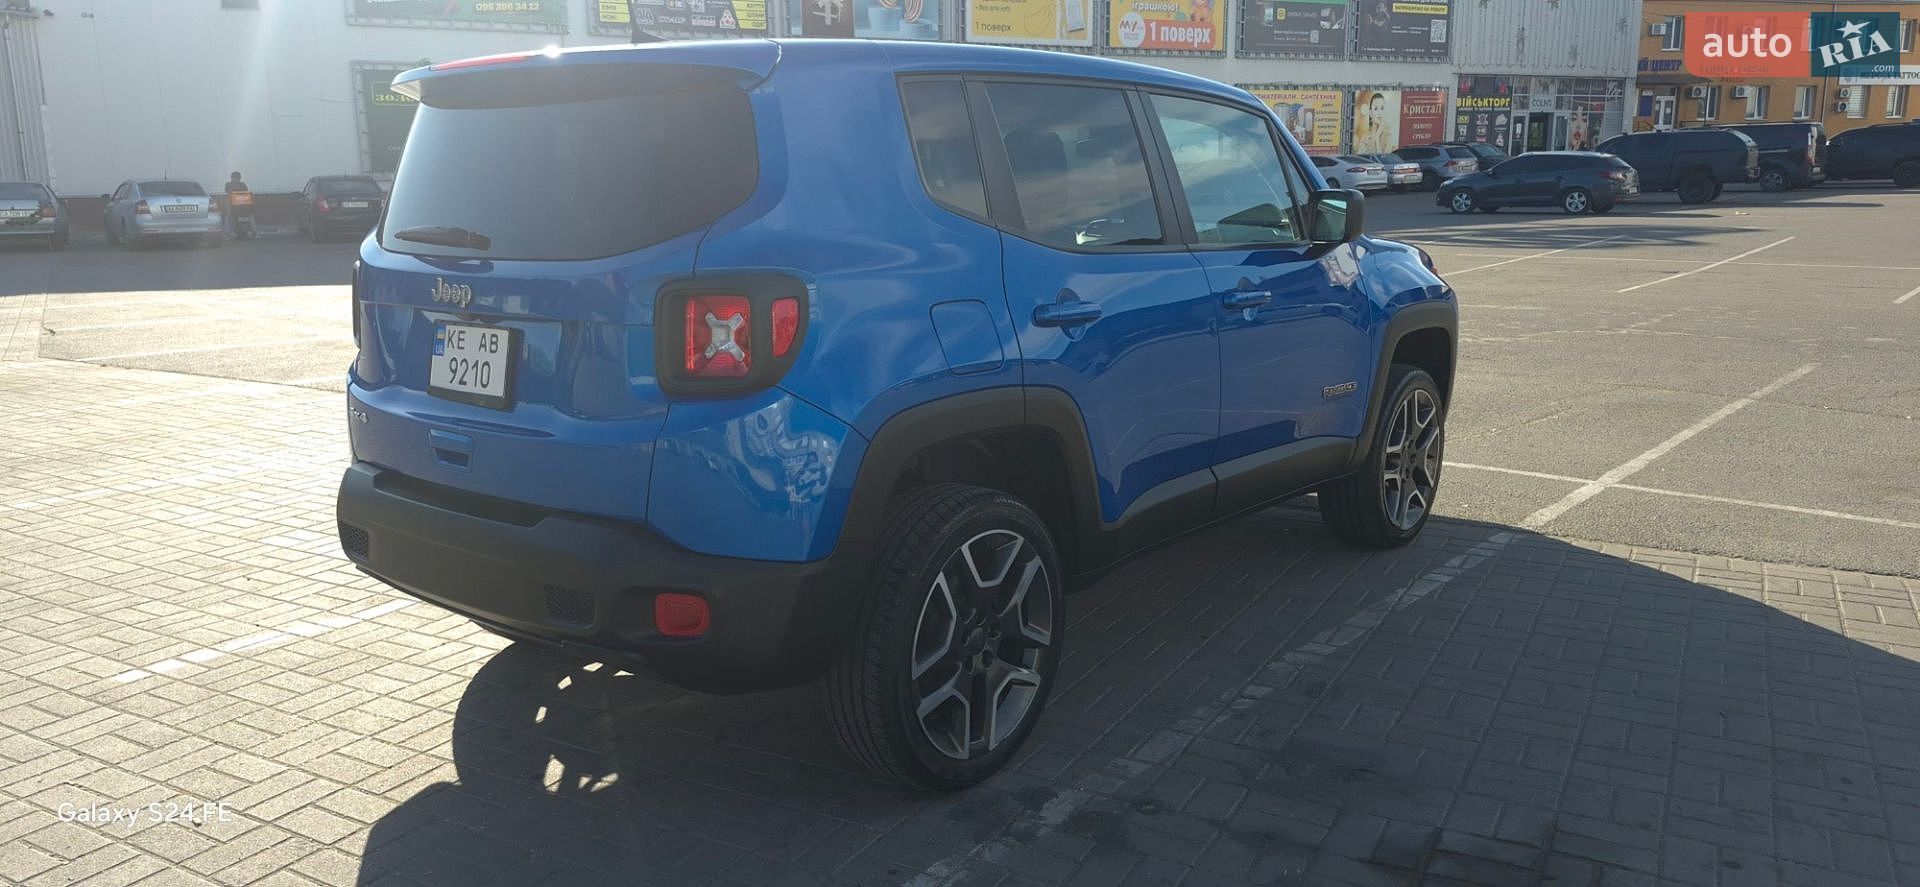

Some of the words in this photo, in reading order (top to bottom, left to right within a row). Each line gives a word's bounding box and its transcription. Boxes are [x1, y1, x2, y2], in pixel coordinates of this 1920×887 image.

[1150, 22, 1156, 41] 1
[1161, 26, 1210, 48] поверх
[1456, 95, 1511, 108] ВІЙСЬКТОРГ
[431, 277, 472, 309] Jeep
[447, 329, 466, 350] KE
[478, 332, 499, 354] AB
[449, 356, 491, 389] 9210
